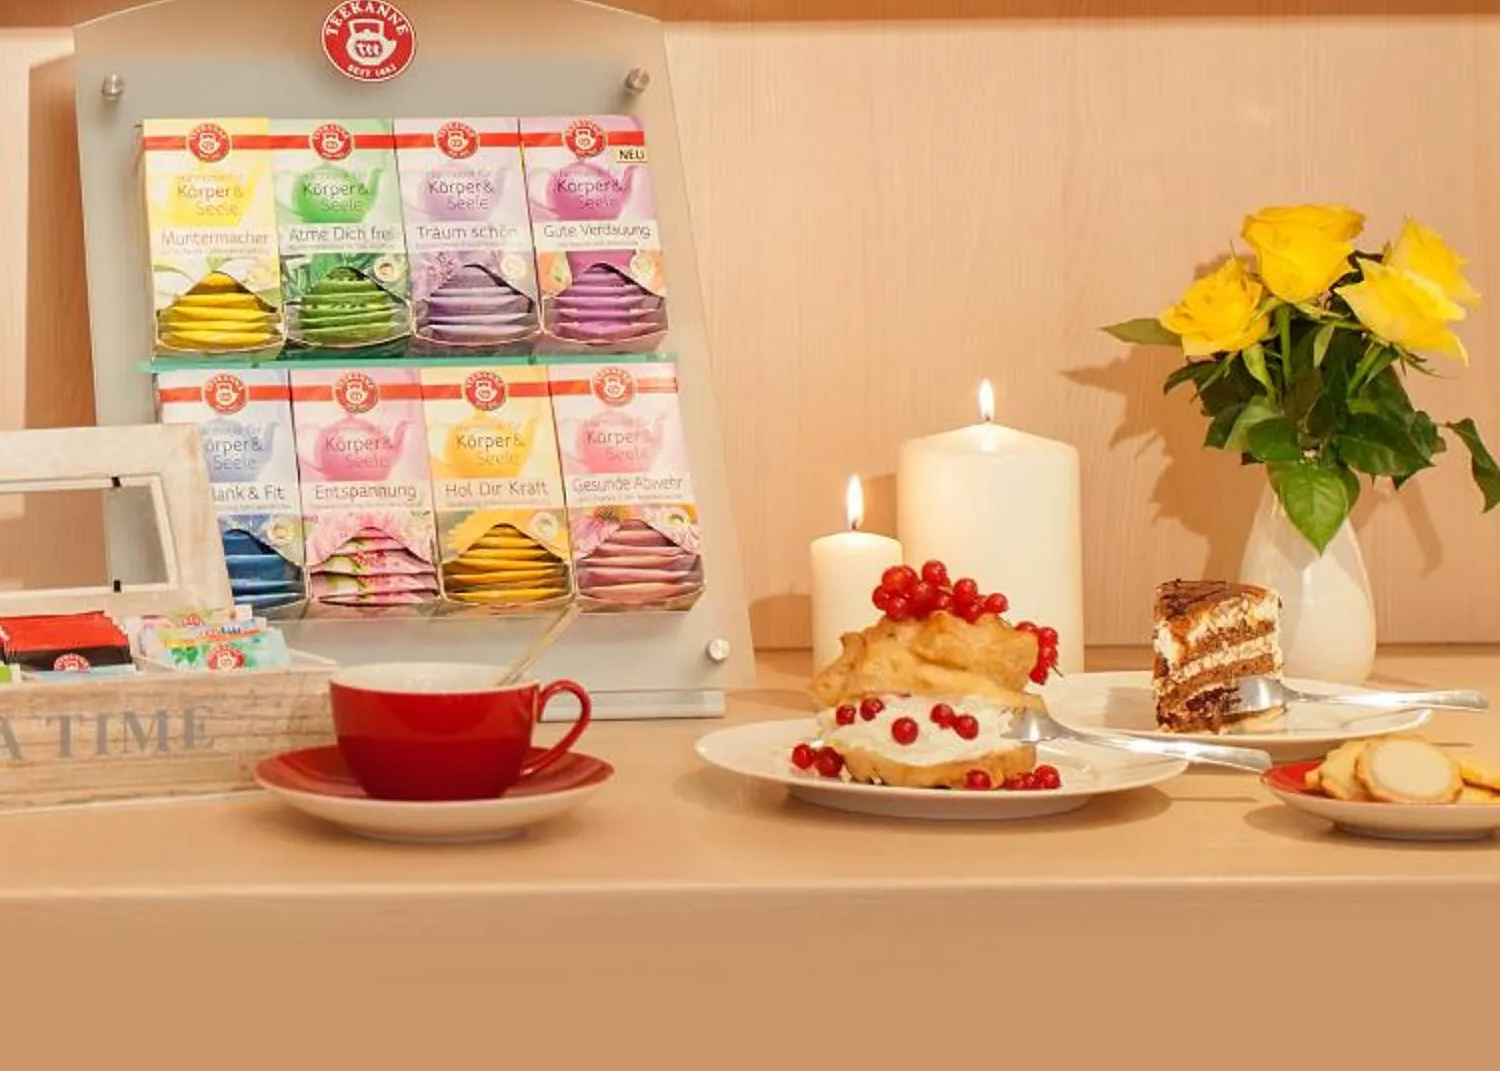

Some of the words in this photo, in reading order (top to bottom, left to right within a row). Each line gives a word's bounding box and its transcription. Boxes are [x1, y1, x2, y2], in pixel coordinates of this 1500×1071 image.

[619, 149, 645, 161] NEU
[161, 230, 269, 247] Muntermacher
[333, 226, 366, 241] Dich
[543, 224, 577, 238] Gute
[579, 223, 651, 239] Verdauung
[204, 439, 248, 457] örper
[211, 484, 244, 502] lank
[264, 484, 286, 502] Fit
[315, 483, 418, 503] Entspannung
[444, 482, 473, 498] Hol
[479, 481, 503, 496] Dir
[508, 480, 549, 496] Kraft
[45, 706, 215, 758] TIME
